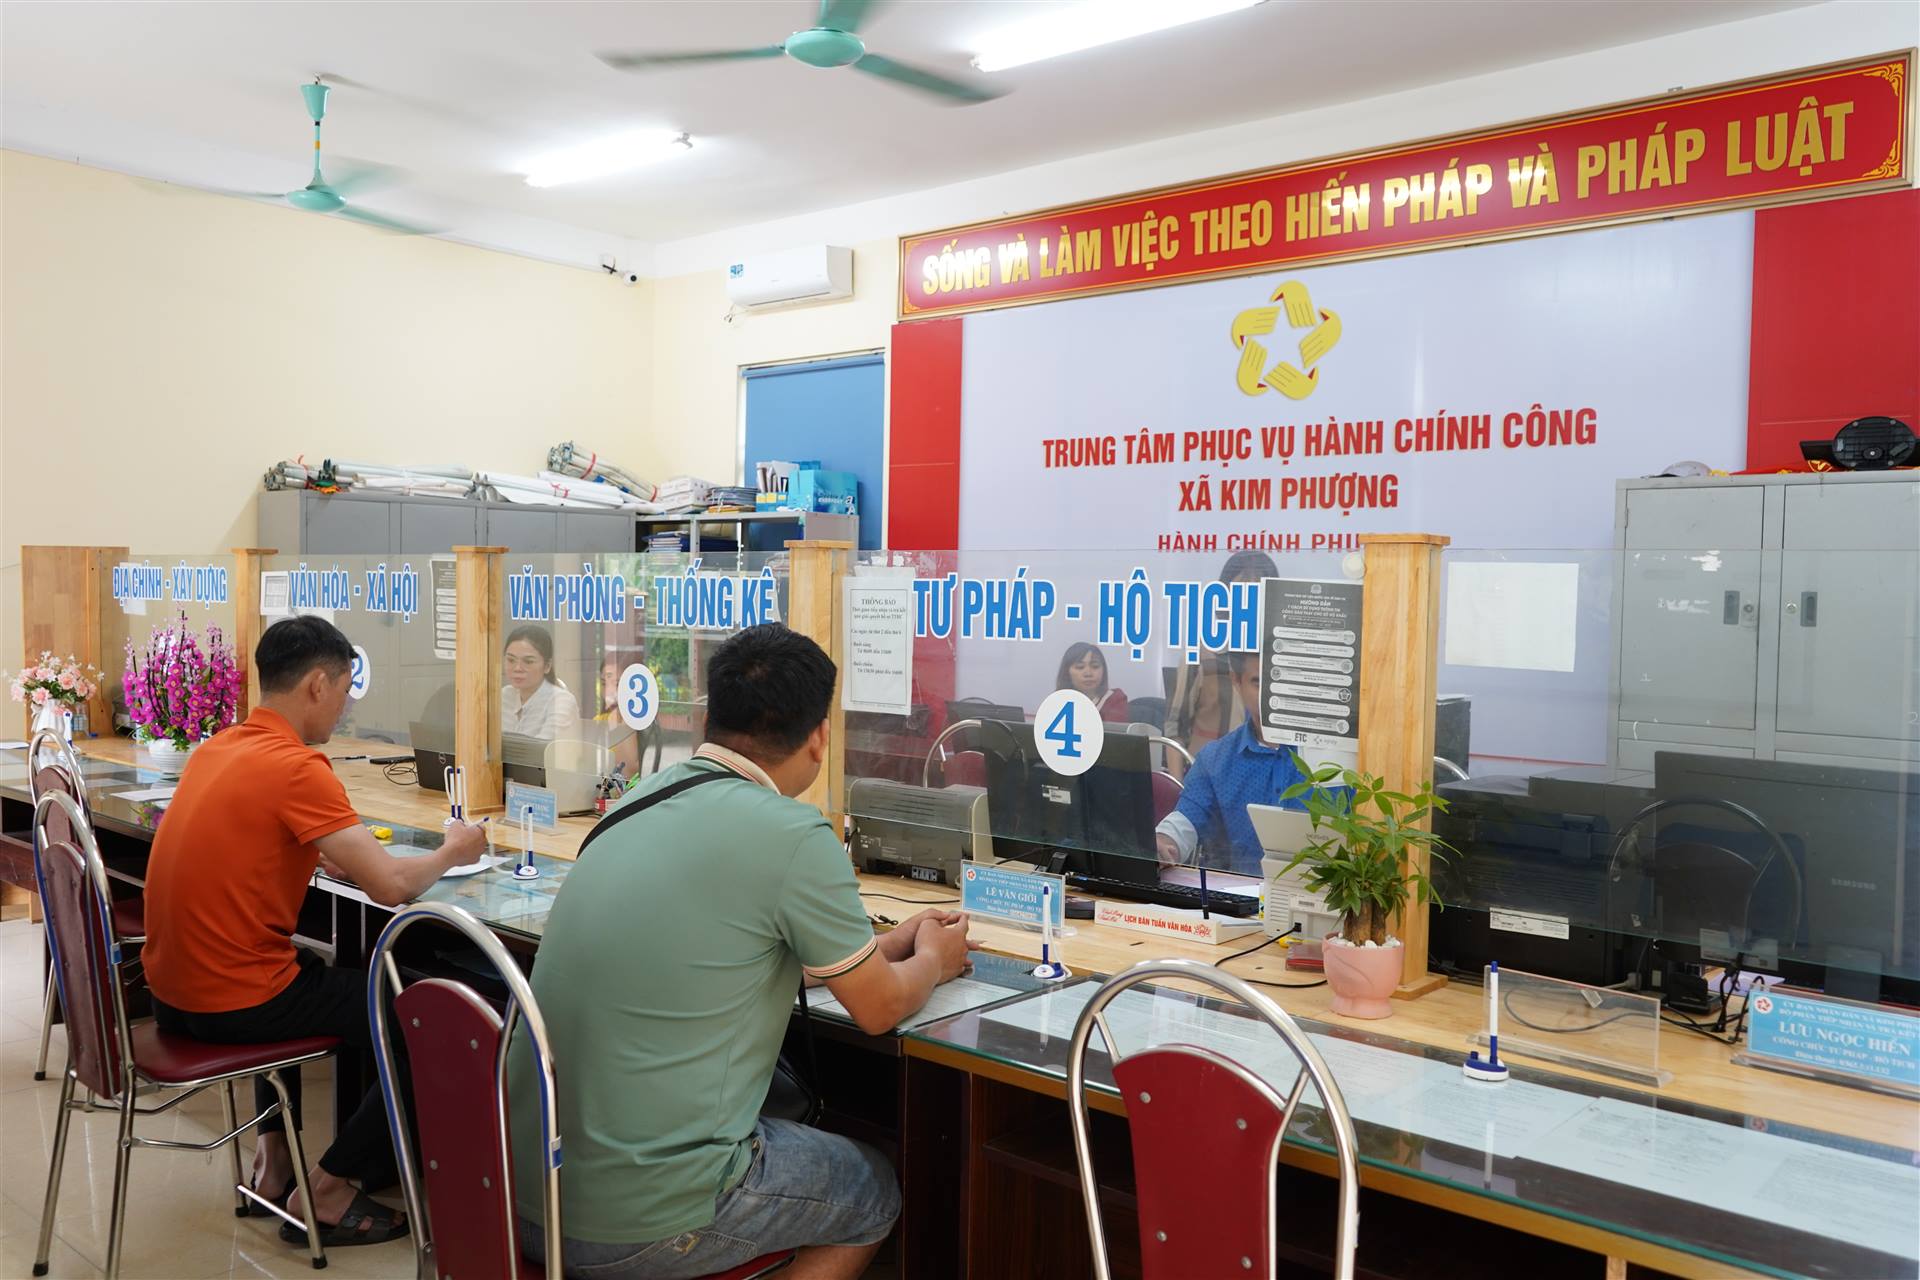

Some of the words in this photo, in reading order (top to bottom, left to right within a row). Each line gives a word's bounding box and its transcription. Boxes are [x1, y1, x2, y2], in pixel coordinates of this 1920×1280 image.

[922, 238, 991, 295] SỐNG
[999, 232, 1029, 284] VÀ
[1040, 227, 1101, 280] LÀM
[1112, 214, 1179, 272] VIỆC
[1190, 200, 1272, 255] THEO
[1285, 171, 1371, 241] HIẾN
[1383, 157, 1493, 228] PHÁP
[1508, 142, 1559, 208] VÀ
[1577, 122, 1706, 199] PHÁP
[1727, 96, 1854, 177] LUẬT
[1042, 435, 1116, 469] TRUNG
[1124, 428, 1175, 465] TÂM
[1183, 428, 1252, 468] PHỤC
[1260, 425, 1295, 465] VỤ
[1304, 416, 1383, 457] HÀNH
[1393, 409, 1491, 453] CHÍNH
[1502, 403, 1597, 448] CÔNG
[1179, 475, 1212, 512] XÃ
[1220, 478, 1271, 510] KIM
[1280, 473, 1398, 516] PHƯỢNG
[1158, 531, 1217, 552] HÀNH
[1227, 530, 1300, 552] CHÍNH
[113, 567, 130, 605] ĐỊA
[131, 560, 163, 599] CHÍNH
[172, 560, 193, 601] XÂY
[196, 564, 228, 609] DỰNG
[290, 563, 318, 609] VĂN
[321, 565, 350, 610] HÓA
[366, 564, 388, 612] XÃ
[391, 564, 418, 622] HỘI
[509, 565, 549, 620] VĂN
[554, 562, 625, 623] PHÒNG
[654, 559, 734, 628] THỐNG
[741, 567, 775, 627] KÊ
[912, 574, 956, 636] TƯ
[962, 567, 1055, 640] PHÁP
[1098, 568, 1150, 660] HỘ
[1164, 582, 1259, 663] TỊCH
[351, 655, 365, 689] 2
[627, 673, 649, 720] 3
[1043, 700, 1083, 758] 4
[1294, 732, 1308, 743] ETC
[986, 886, 997, 897] LÊ
[998, 888, 1016, 899] VĂN
[1124, 914, 1137, 924] LỊCH
[1816, 1028, 1865, 1048] NGỌC
